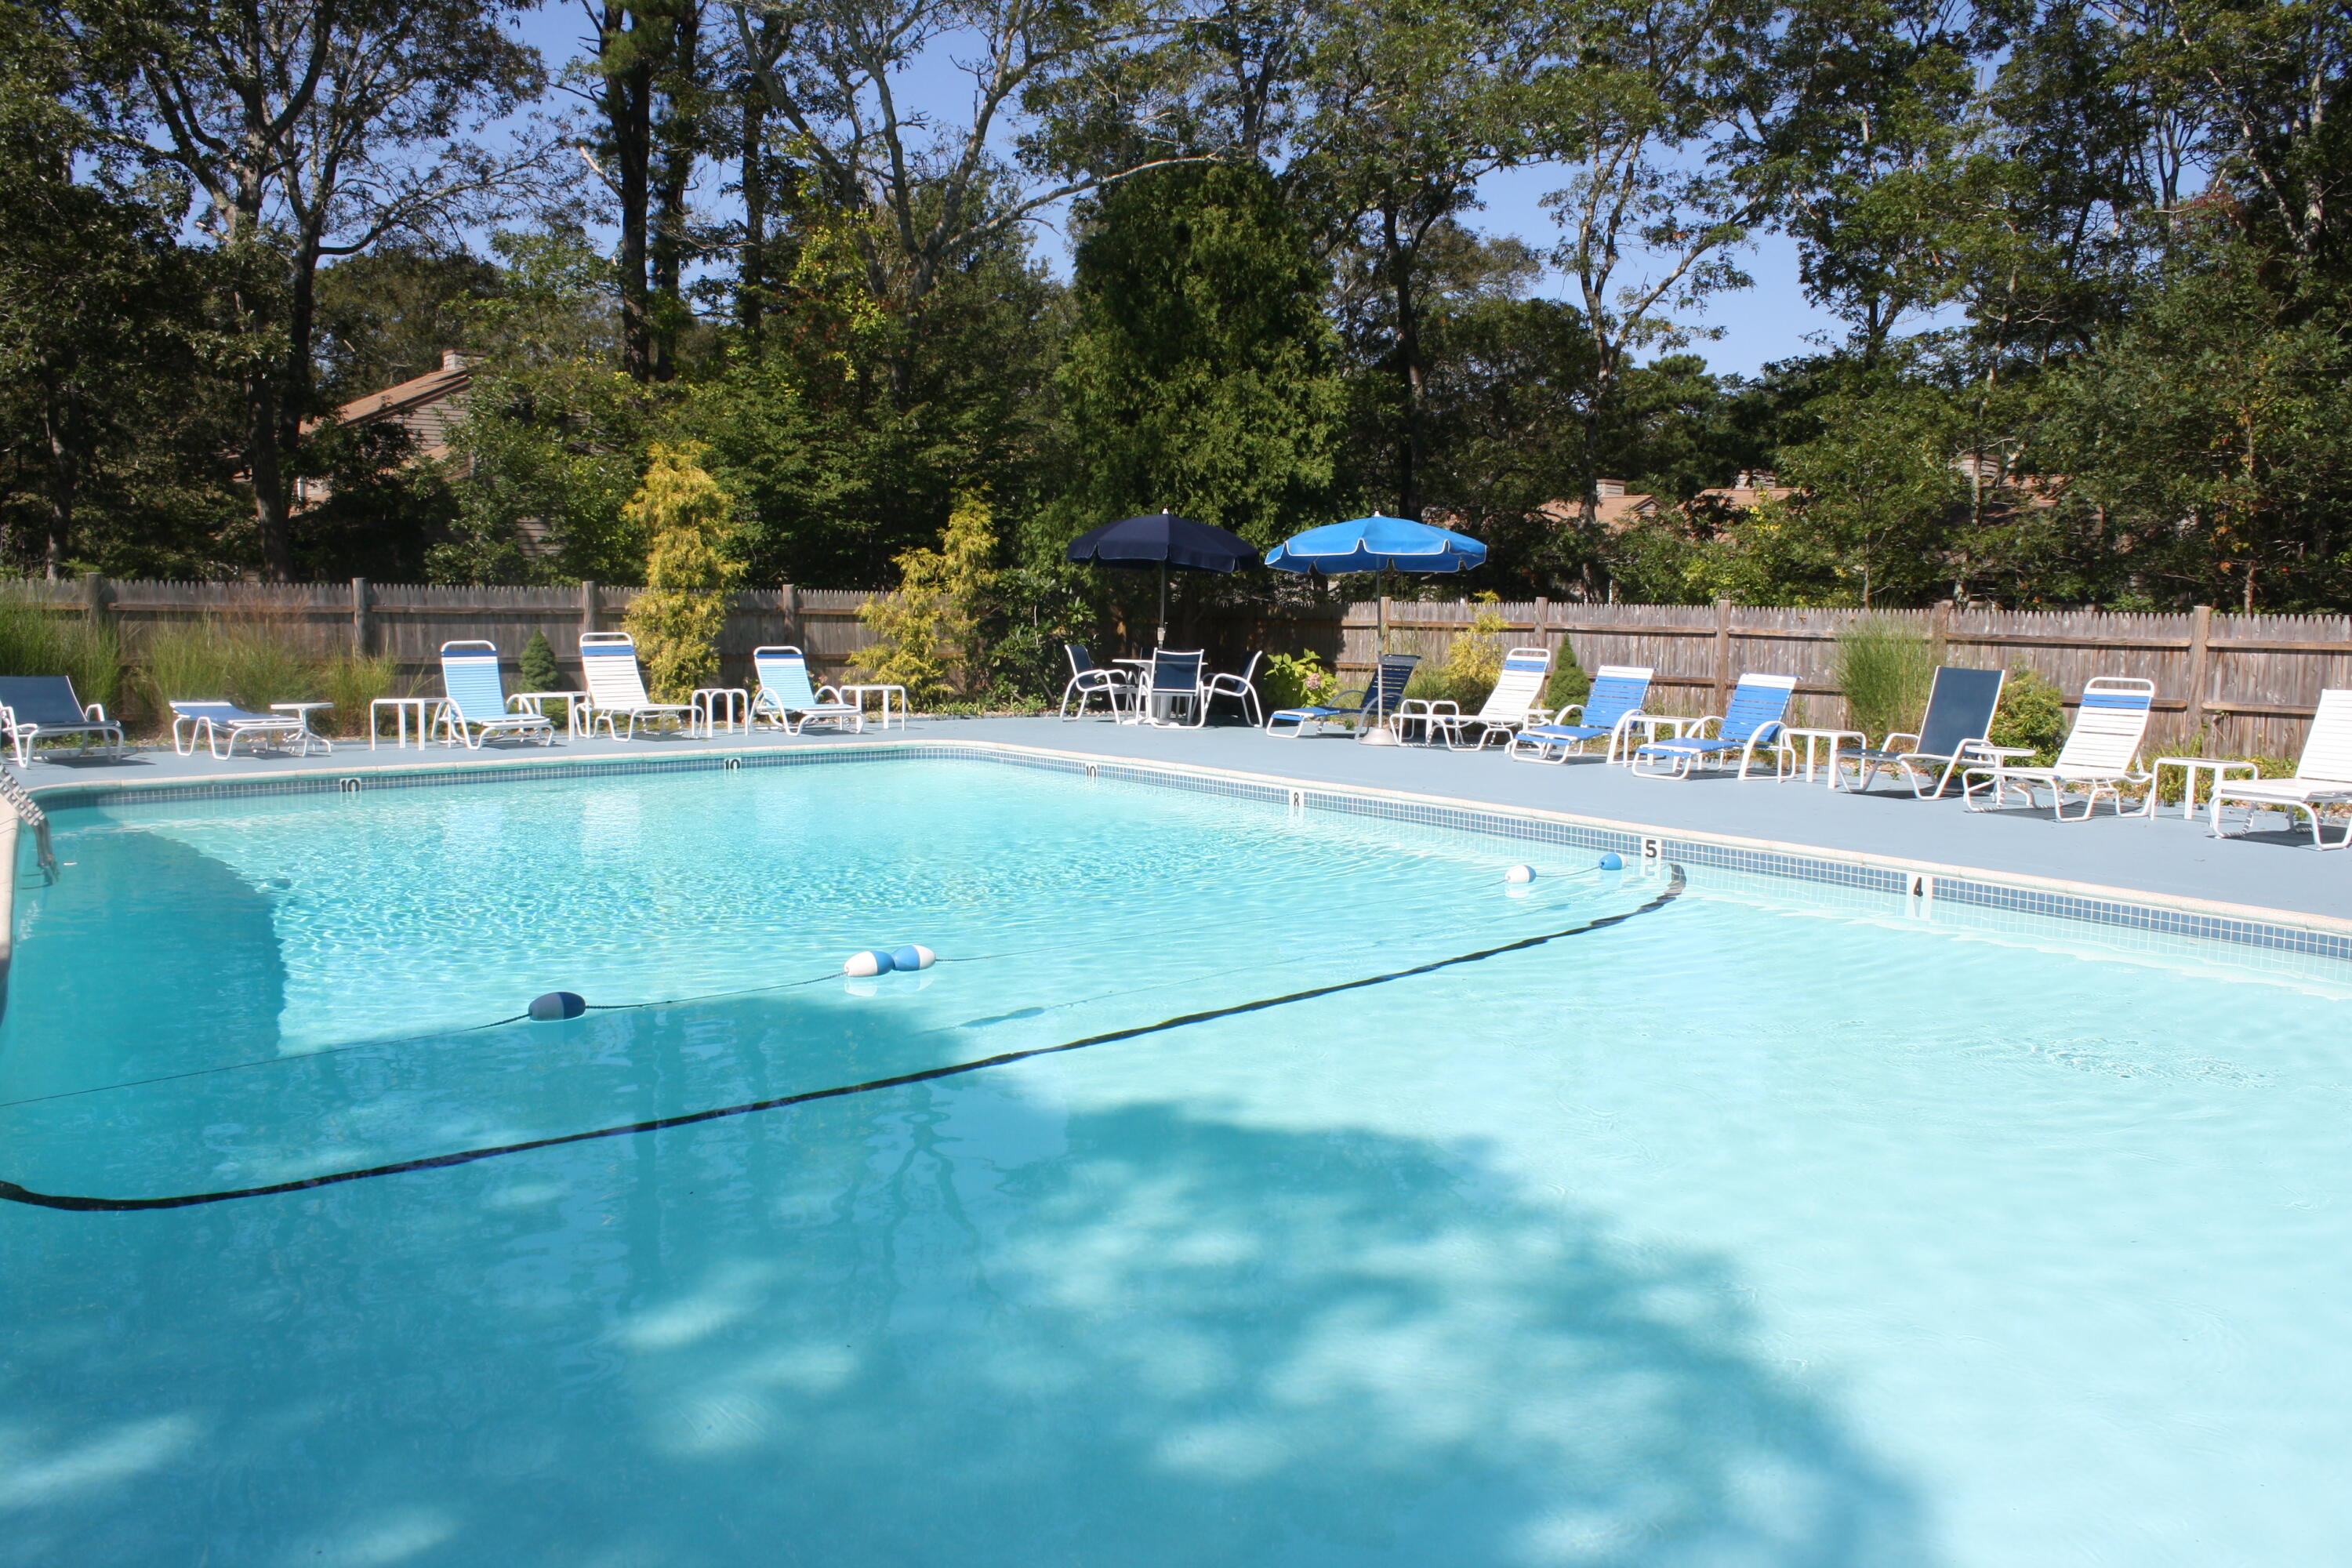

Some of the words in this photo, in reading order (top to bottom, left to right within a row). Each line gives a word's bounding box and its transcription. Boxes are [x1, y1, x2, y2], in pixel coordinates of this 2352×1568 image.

[725, 758, 741, 770] 10
[1086, 764, 1097, 777] 10
[341, 779, 361, 793] 10
[1294, 792, 1299, 807] 8
[1645, 839, 1657, 858] 5
[1913, 877, 1923, 897] 4
